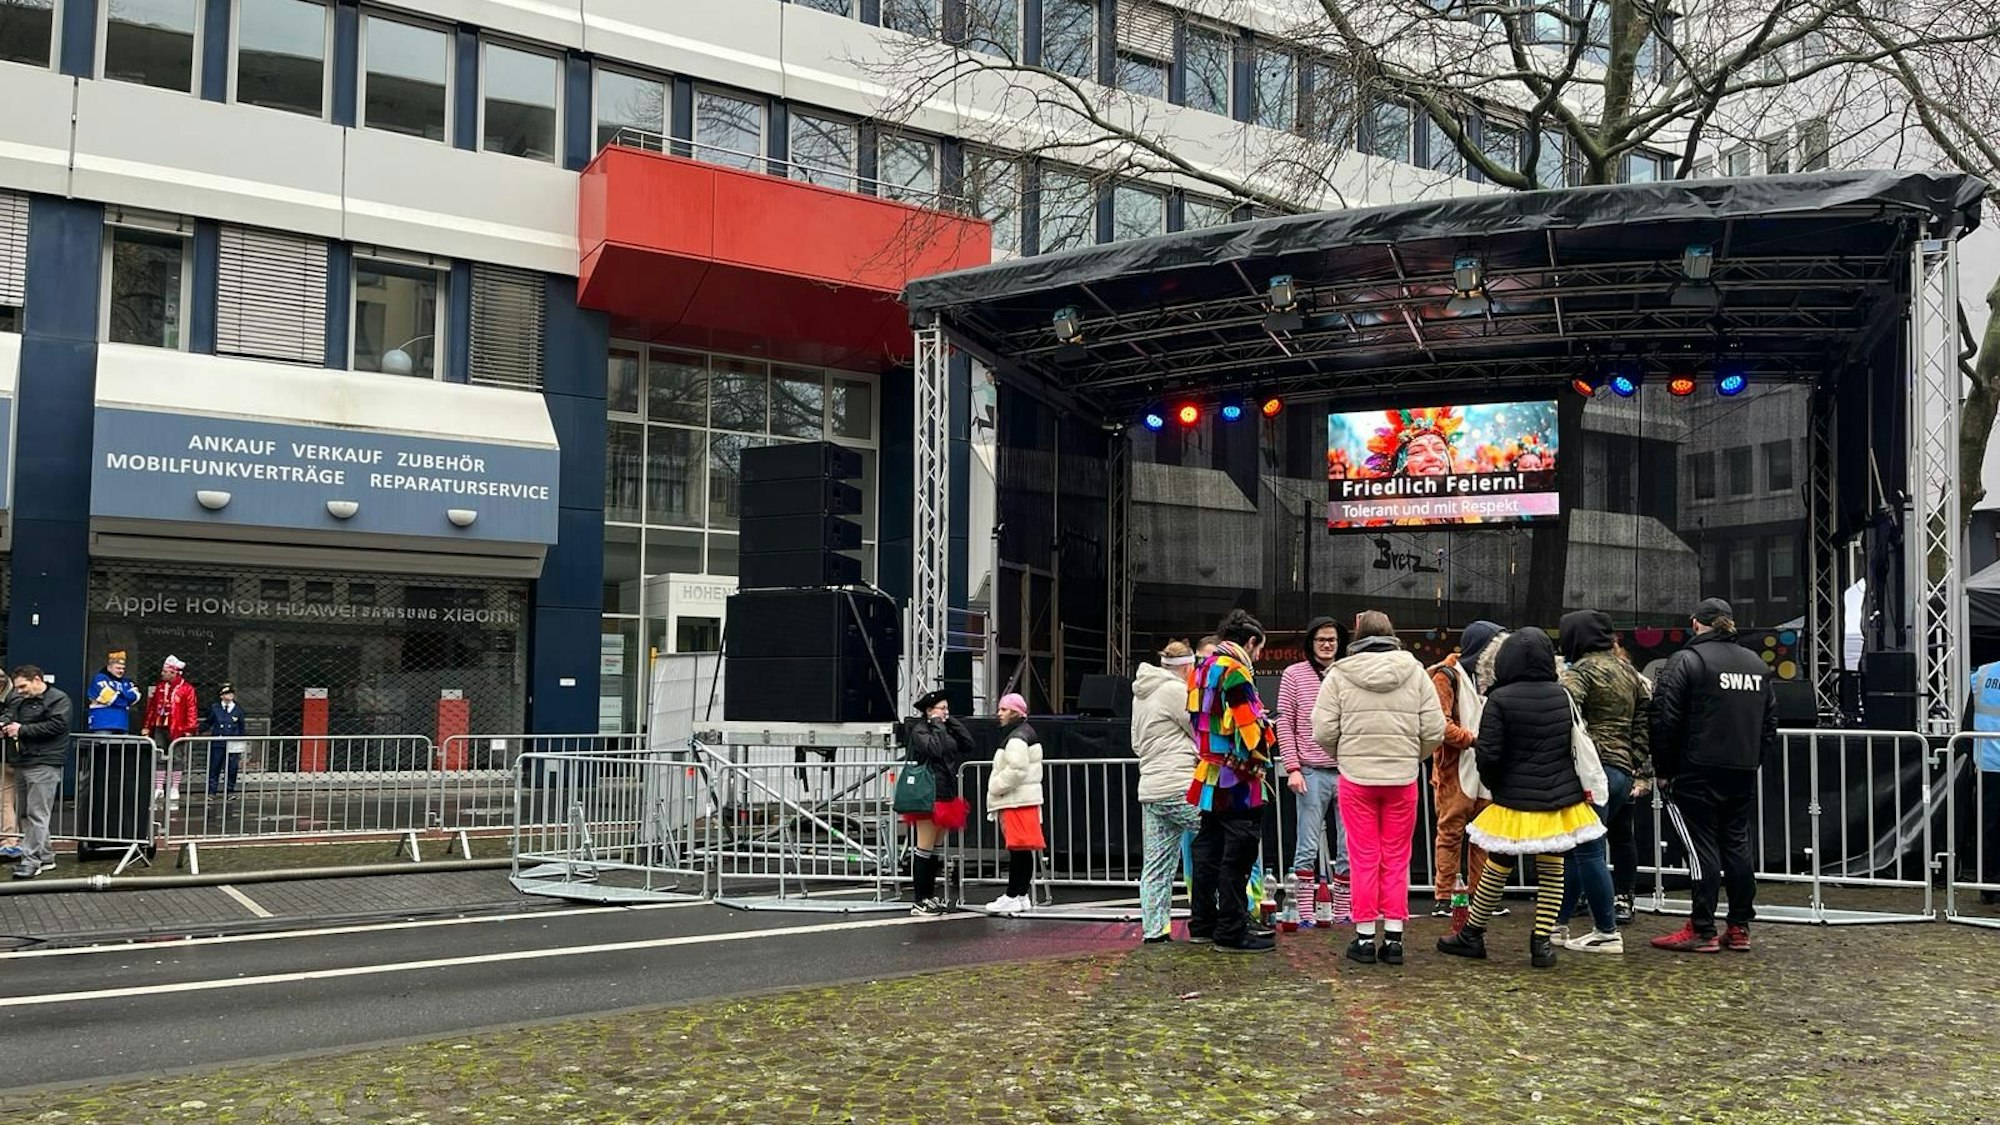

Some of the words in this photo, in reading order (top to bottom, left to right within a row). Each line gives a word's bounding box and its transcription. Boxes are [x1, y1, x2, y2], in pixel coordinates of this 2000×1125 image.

[188, 435, 276, 456] ANKAUF
[292, 443, 382, 465] VERKAUF
[397, 452, 485, 473] ZUBEHÖR
[107, 453, 345, 485] MOBILFUNKVERTRÄGE
[370, 473, 549, 500] REPARATURSERVICE
[1342, 476, 1437, 497] Friedlich
[1447, 473, 1525, 492] Feiern!
[1342, 503, 1398, 518] Tolerant
[1402, 502, 1431, 516] und
[1436, 501, 1457, 515] mit
[1462, 499, 1519, 516] Respekt
[1373, 538, 1439, 573] Bretz
[105, 592, 178, 617] Apple
[186, 597, 269, 616] HONOR
[276, 602, 356, 619] HUAWEI
[362, 607, 437, 620] SAMSUNG
[1719, 672, 1763, 691] SWAT
